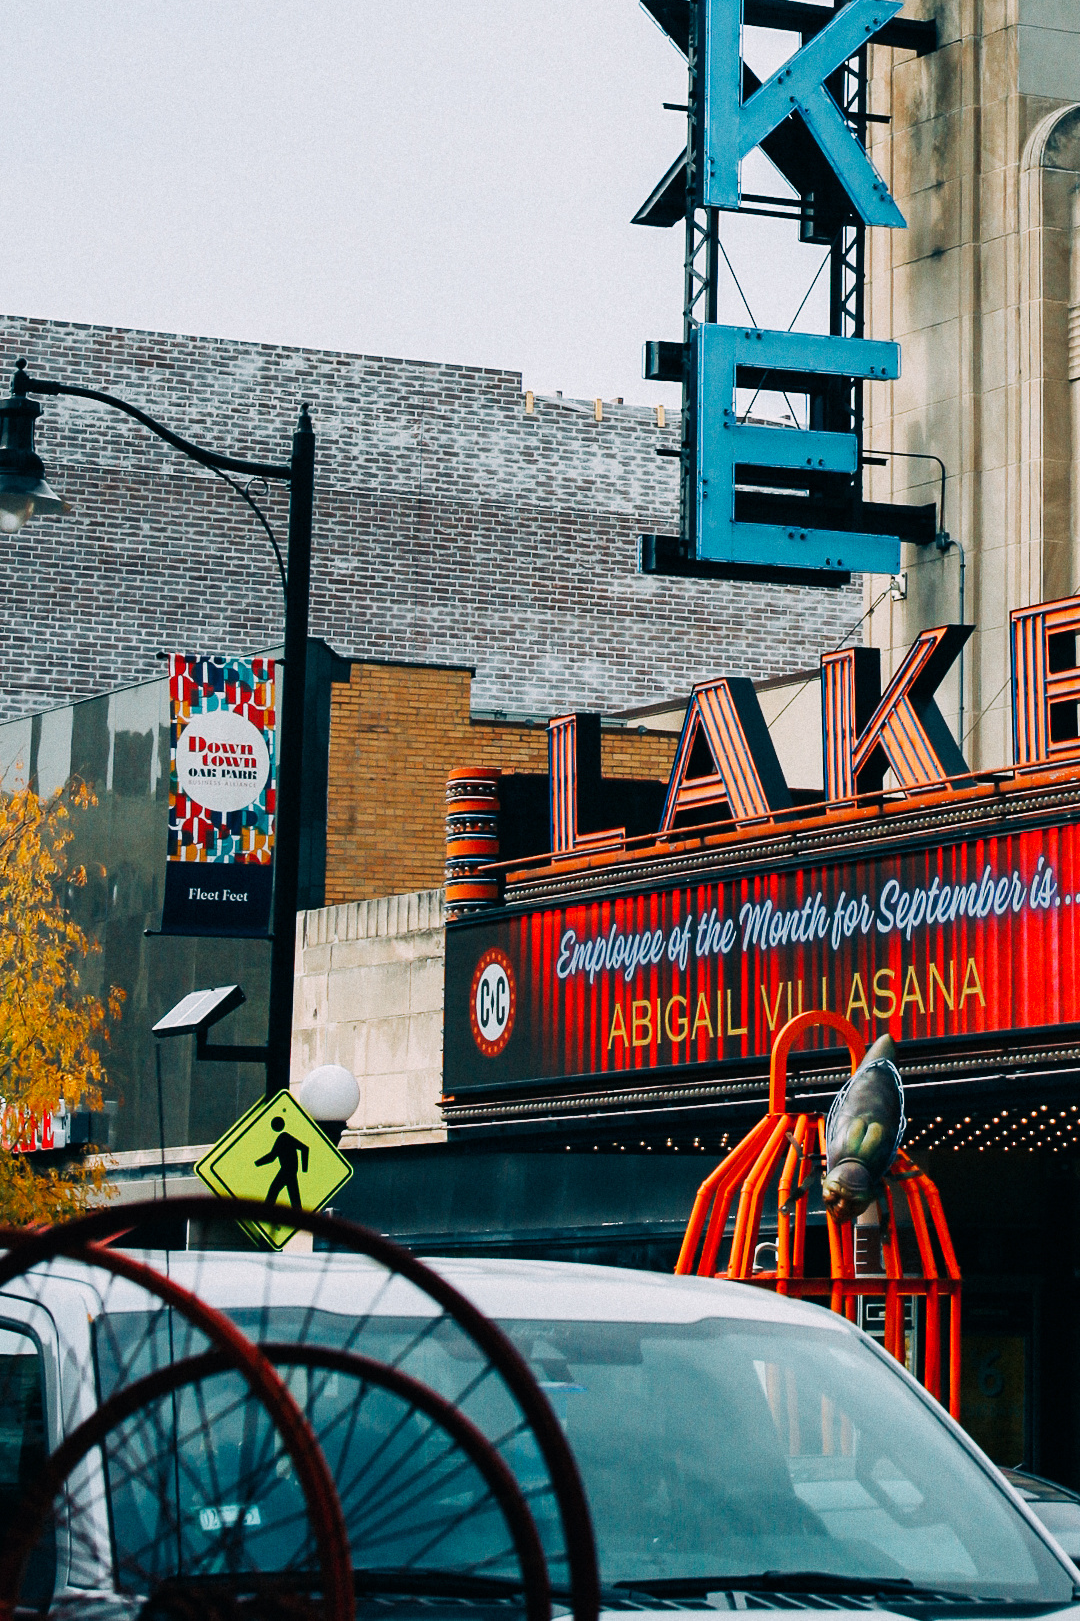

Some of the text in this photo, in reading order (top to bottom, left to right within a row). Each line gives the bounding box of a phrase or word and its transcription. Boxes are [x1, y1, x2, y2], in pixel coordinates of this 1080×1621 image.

[189, 736, 254, 755] Down
[202, 752, 257, 768] town
[188, 768, 258, 780] OAK PARK
[188, 887, 249, 902] Fleet Feet
[556, 923, 667, 984] Employee
[667, 914, 692, 972] of
[695, 907, 737, 956] the
[738, 891, 831, 952] Month
[830, 890, 875, 951] for
[876, 864, 1027, 941] September
[607, 989, 749, 1050] ABIGAIL
